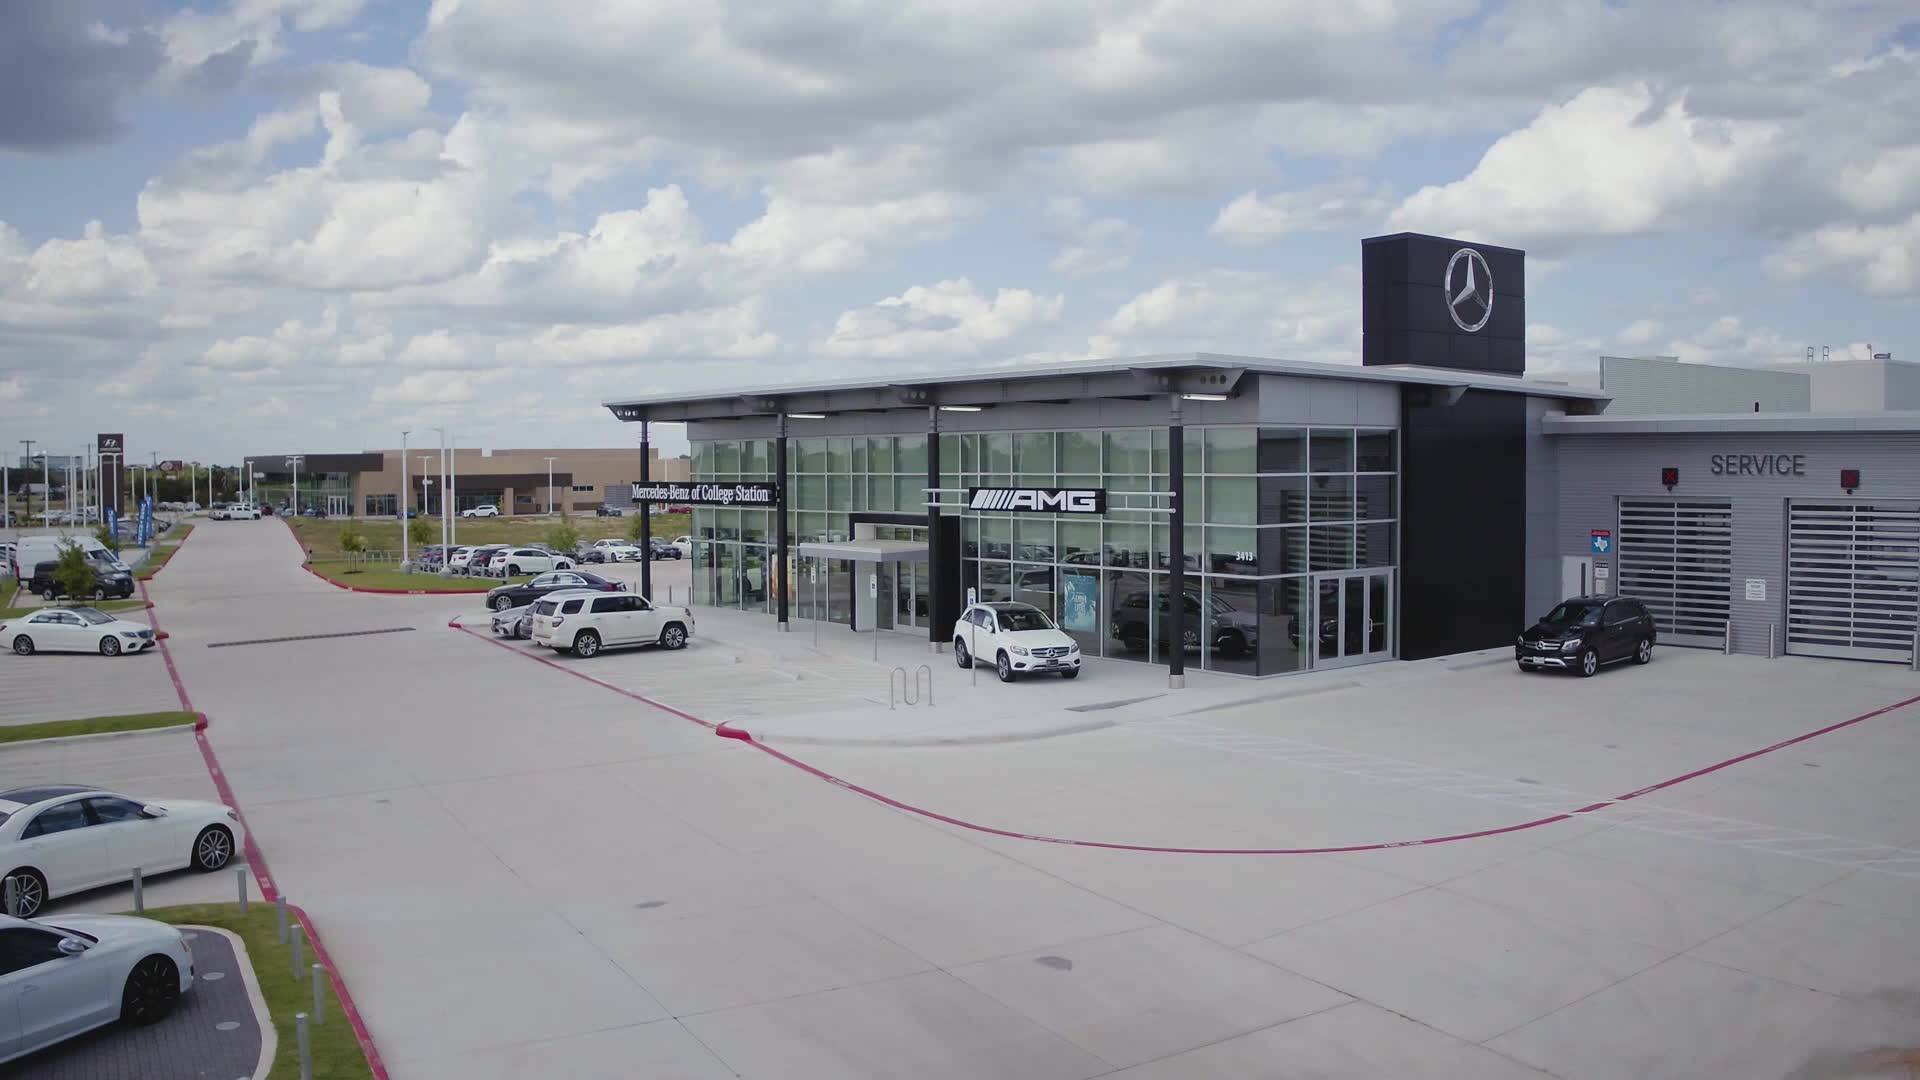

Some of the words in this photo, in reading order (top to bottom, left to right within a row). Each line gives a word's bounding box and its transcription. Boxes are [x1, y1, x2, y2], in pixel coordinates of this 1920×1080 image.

[1711, 454, 1806, 476] SERVICE
[631, 484, 689, 500] Mercedes-Benz
[691, 485, 701, 500] of
[701, 485, 734, 504] College
[735, 486, 769, 502] Station
[1007, 490, 1096, 512] AMG
[1235, 551, 1254, 562] 3413
